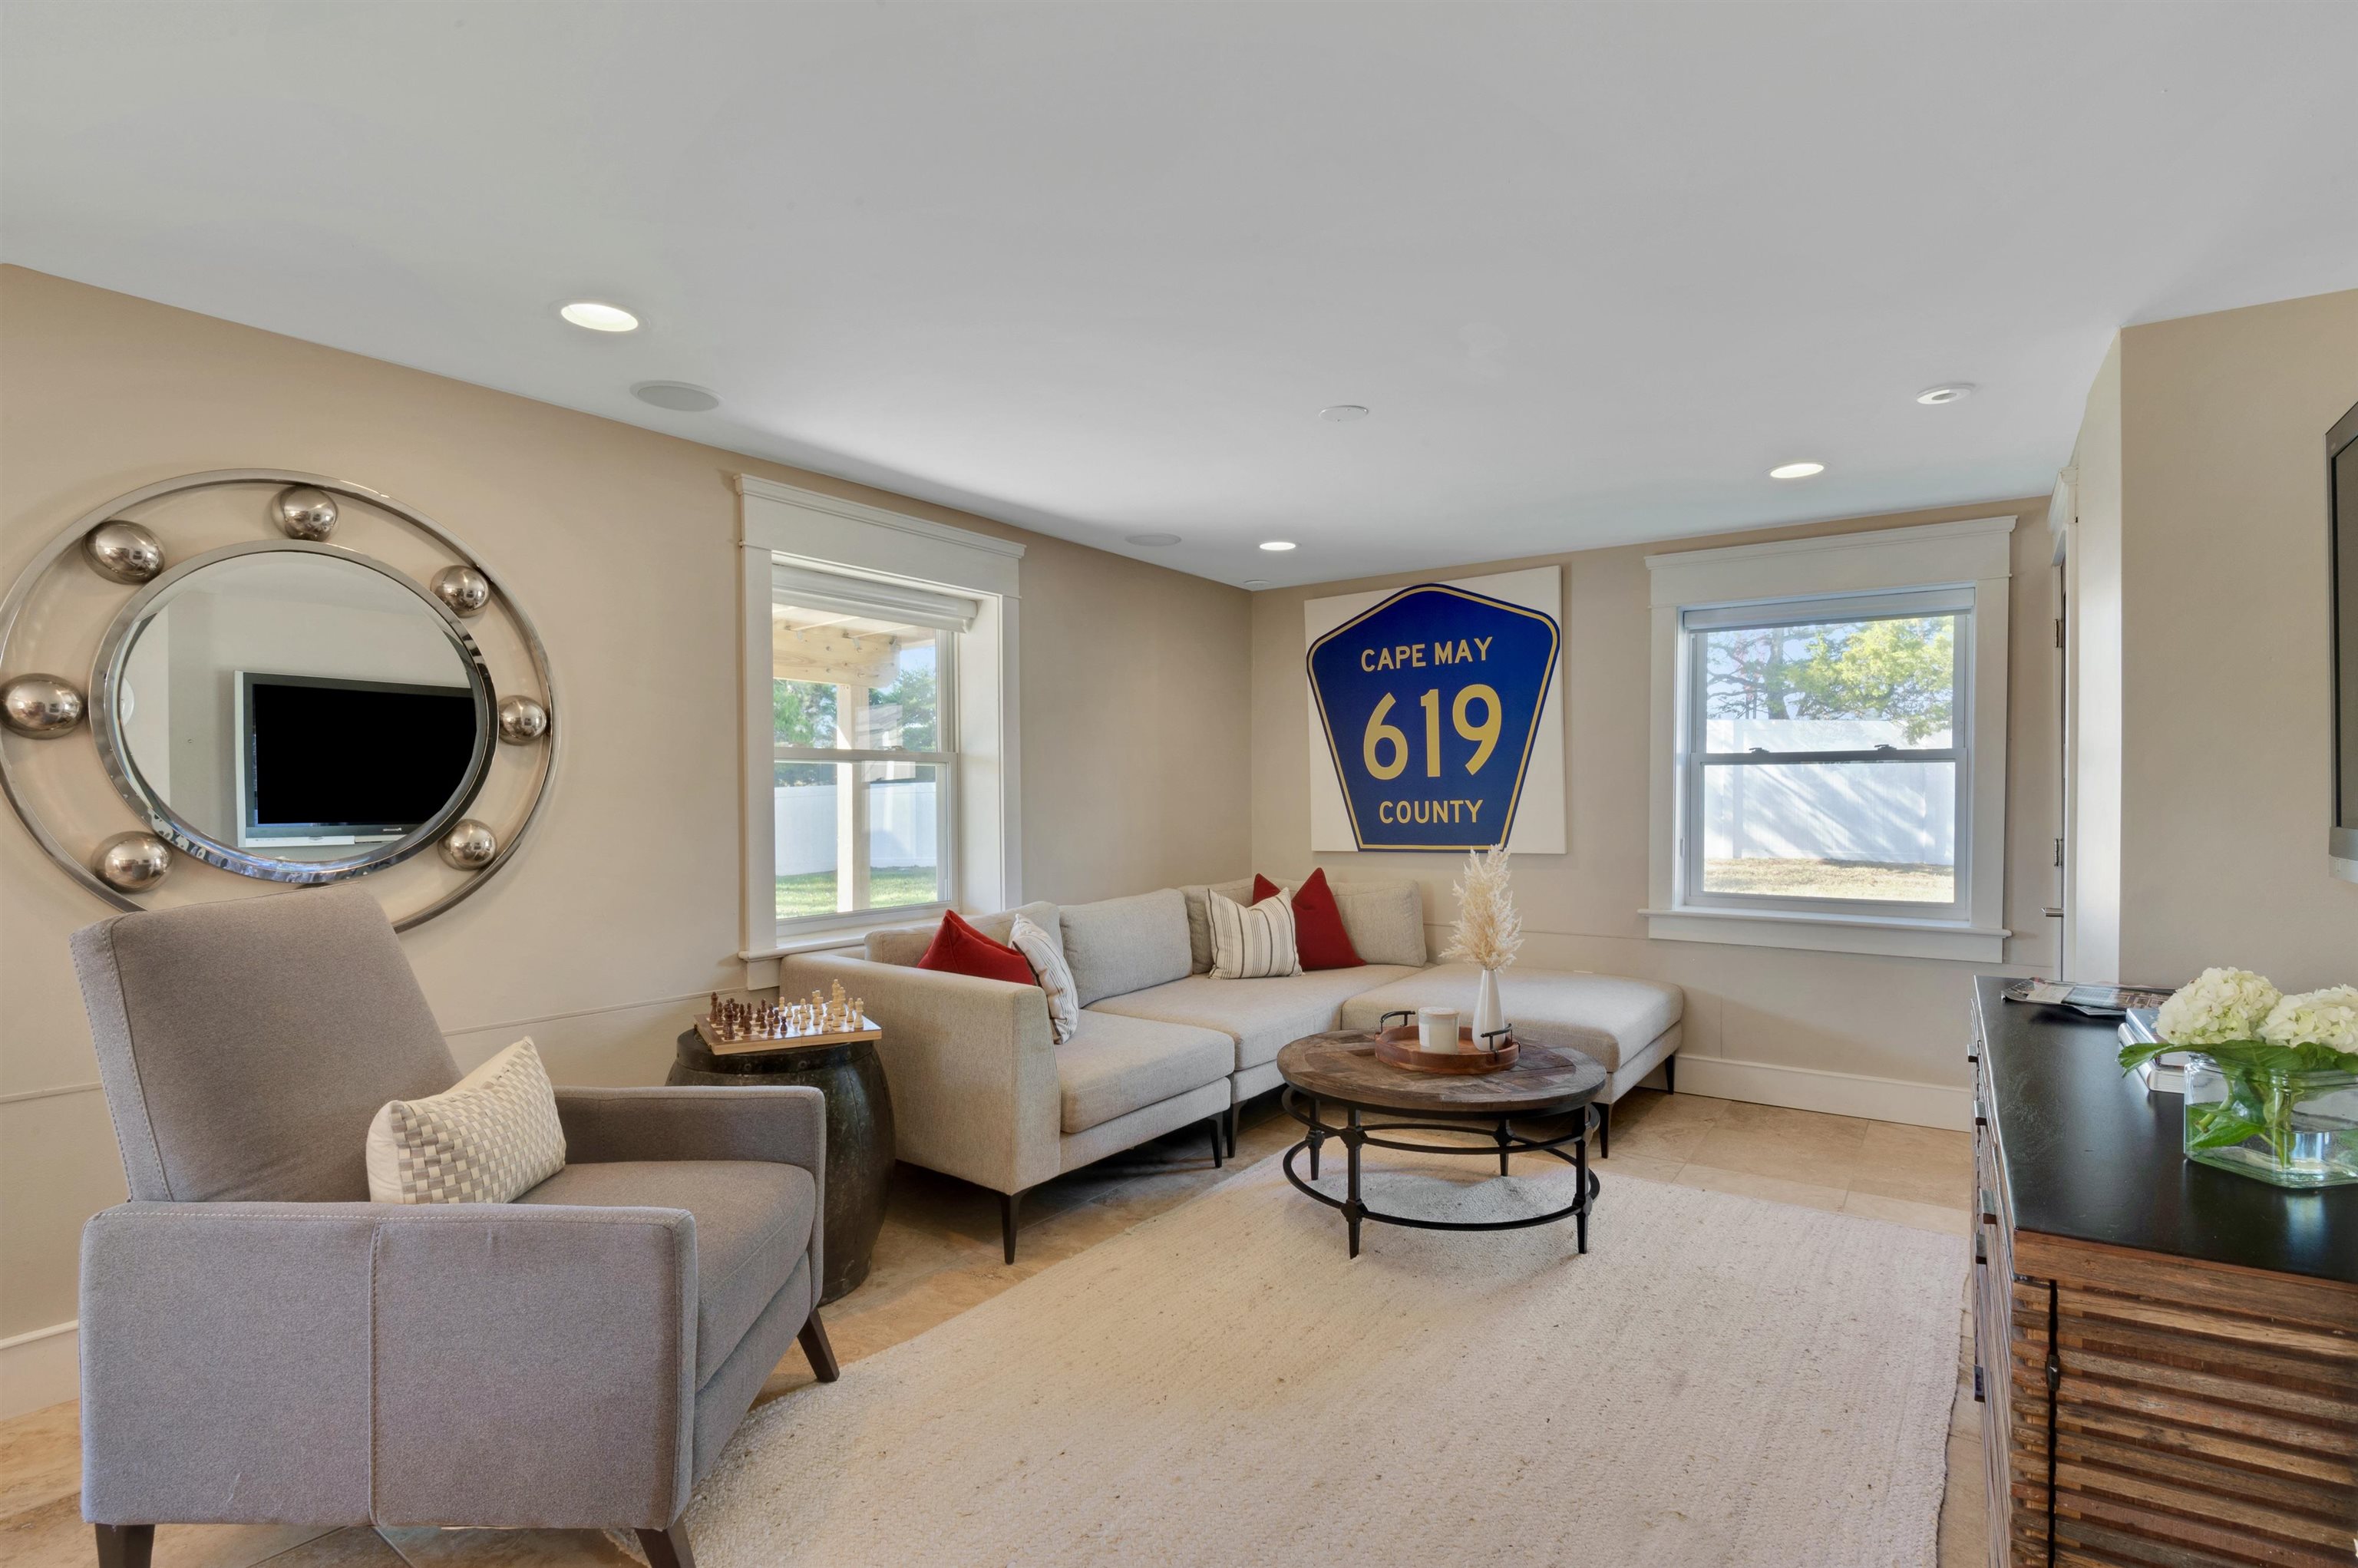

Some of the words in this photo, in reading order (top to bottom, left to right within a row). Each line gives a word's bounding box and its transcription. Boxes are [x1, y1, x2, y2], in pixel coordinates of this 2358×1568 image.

[1361, 643, 1426, 672] CAPE
[1434, 636, 1493, 666] MAY
[1363, 684, 1502, 781] 619
[1379, 800, 1484, 824] COUNTY
